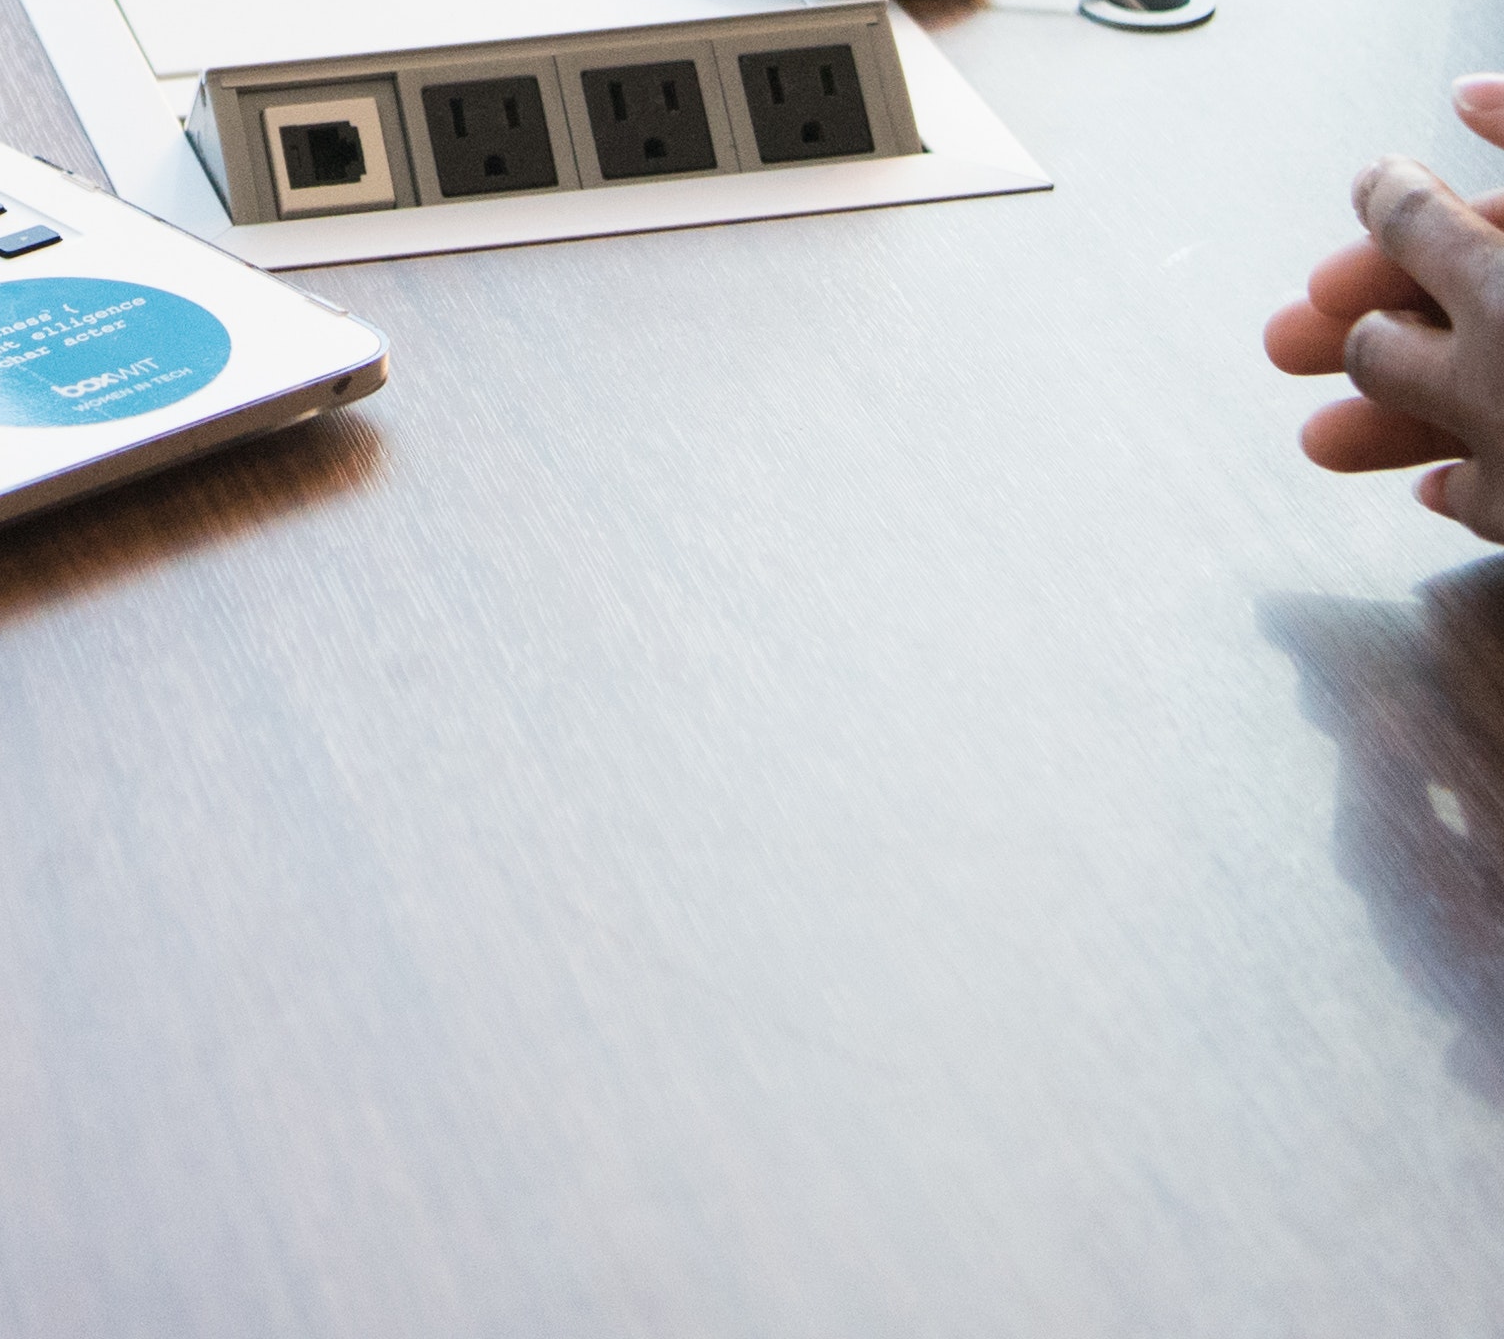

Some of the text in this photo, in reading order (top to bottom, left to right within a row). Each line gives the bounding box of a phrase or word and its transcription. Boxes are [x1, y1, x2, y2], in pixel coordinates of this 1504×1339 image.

[32, 297, 146, 340] elligence
[64, 319, 127, 347] acter
[72, 367, 194, 413] WOMEN IN TECH
